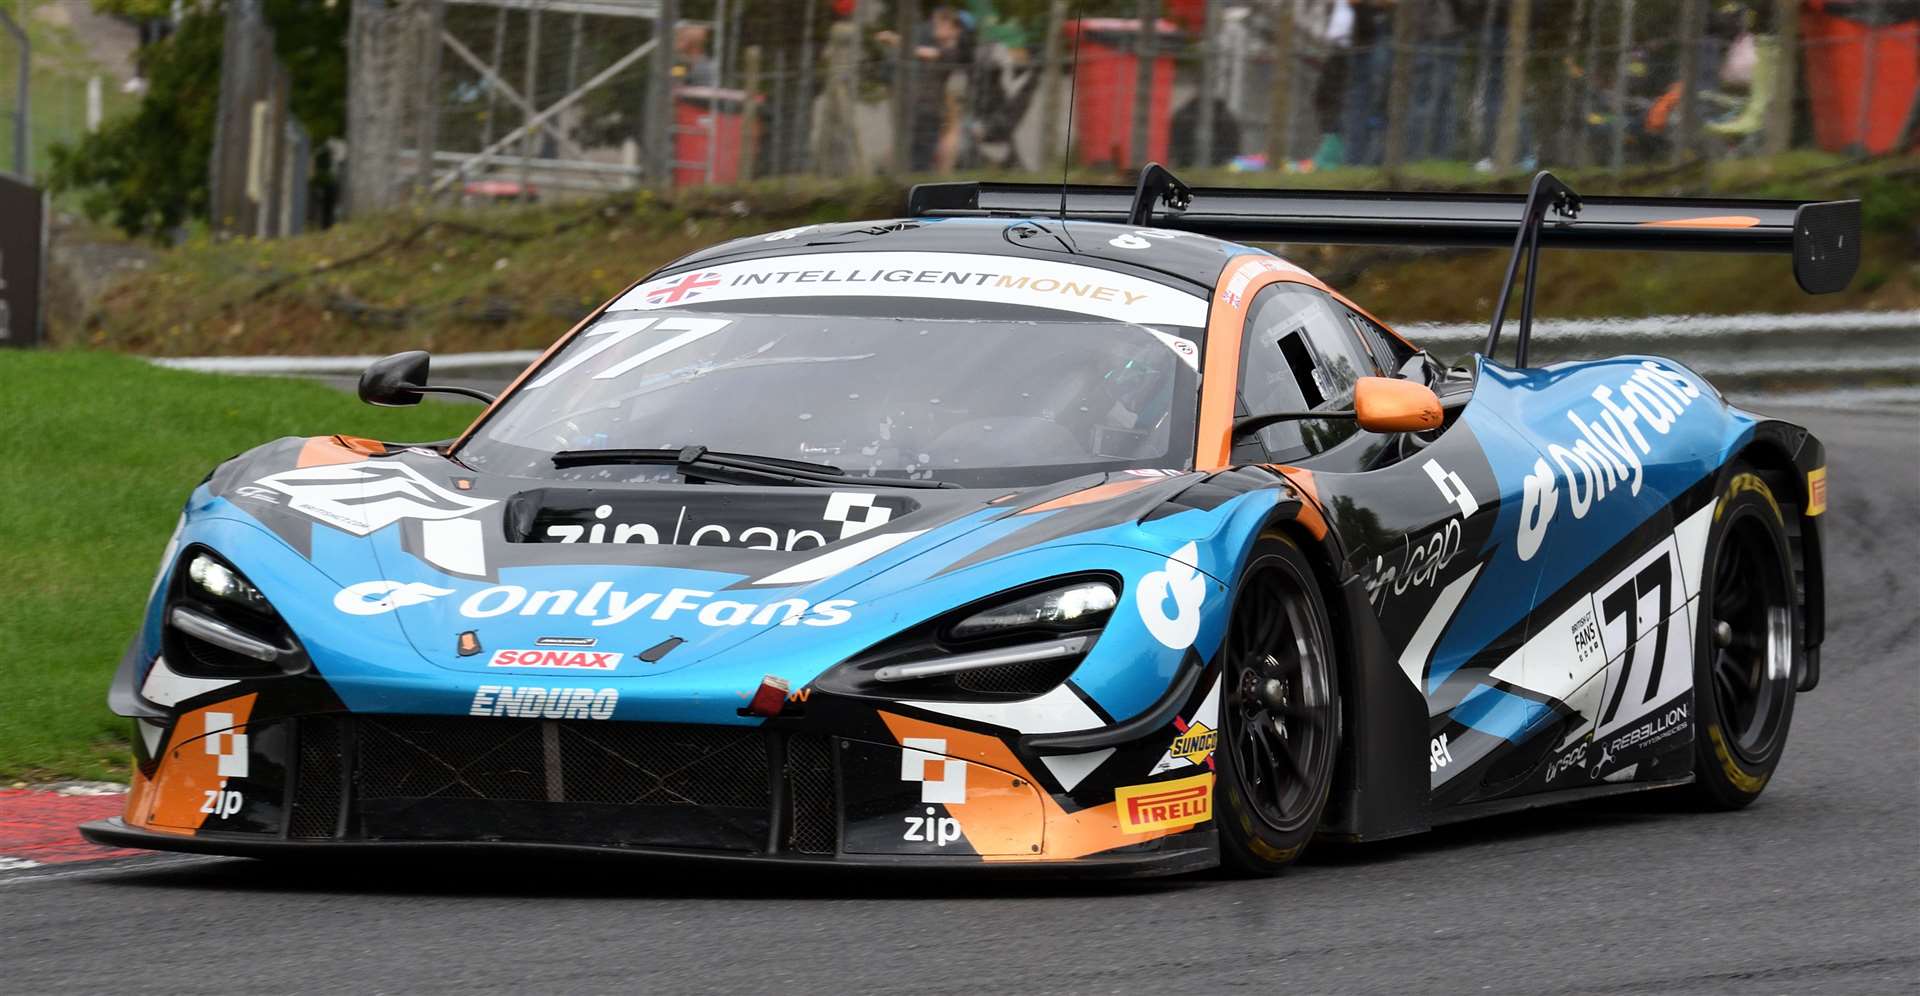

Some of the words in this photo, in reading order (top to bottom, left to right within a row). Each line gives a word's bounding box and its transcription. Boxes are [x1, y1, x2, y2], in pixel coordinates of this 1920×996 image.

[523, 316, 735, 391] 77
[1547, 360, 1701, 520] OnlyFans
[459, 581, 859, 626] OnlyFans
[1573, 622, 1597, 653] FANS
[1598, 550, 1673, 729] 77
[494, 650, 614, 669] SONAX
[469, 684, 620, 720] ENDURO
[199, 780, 244, 820] zip
[1127, 784, 1208, 826] PIRELLI
[902, 805, 962, 847] zip
